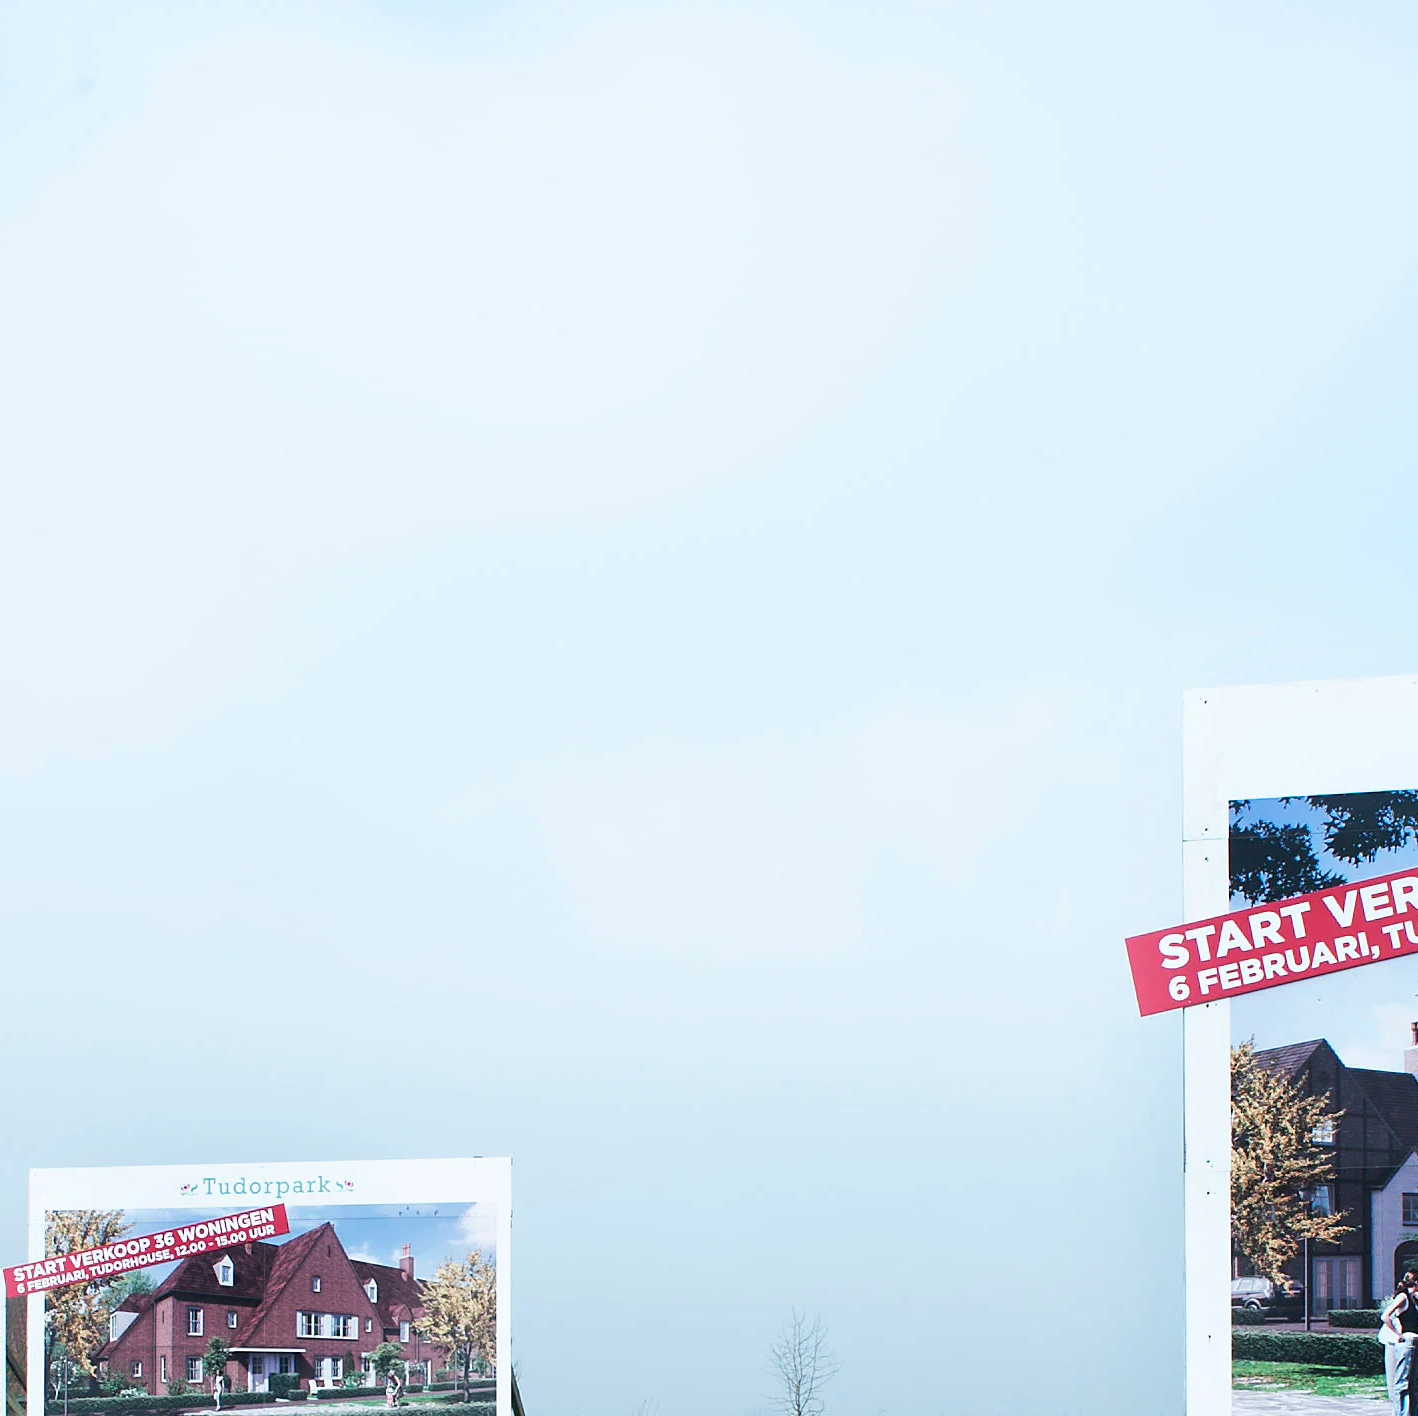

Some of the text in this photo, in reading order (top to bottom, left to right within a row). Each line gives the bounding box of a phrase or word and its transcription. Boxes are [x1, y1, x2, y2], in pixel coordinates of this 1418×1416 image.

[1158, 903, 1311, 969] START
[1168, 975, 1190, 1001] 6
[1197, 931, 1381, 995] FEBRUARI,
[202, 1175, 331, 1198] Tudorpark
[13, 1207, 275, 1282] START VERKOOP 36 WONINGEN
[16, 1282, 25, 1294] 6
[27, 1268, 89, 1291] FEBRUARI,
[89, 1248, 174, 1277] TUDORHOUSE,
[175, 1240, 207, 1257] 12.00
[215, 1230, 247, 1247] 15.00
[248, 1224, 275, 1239] UUR
